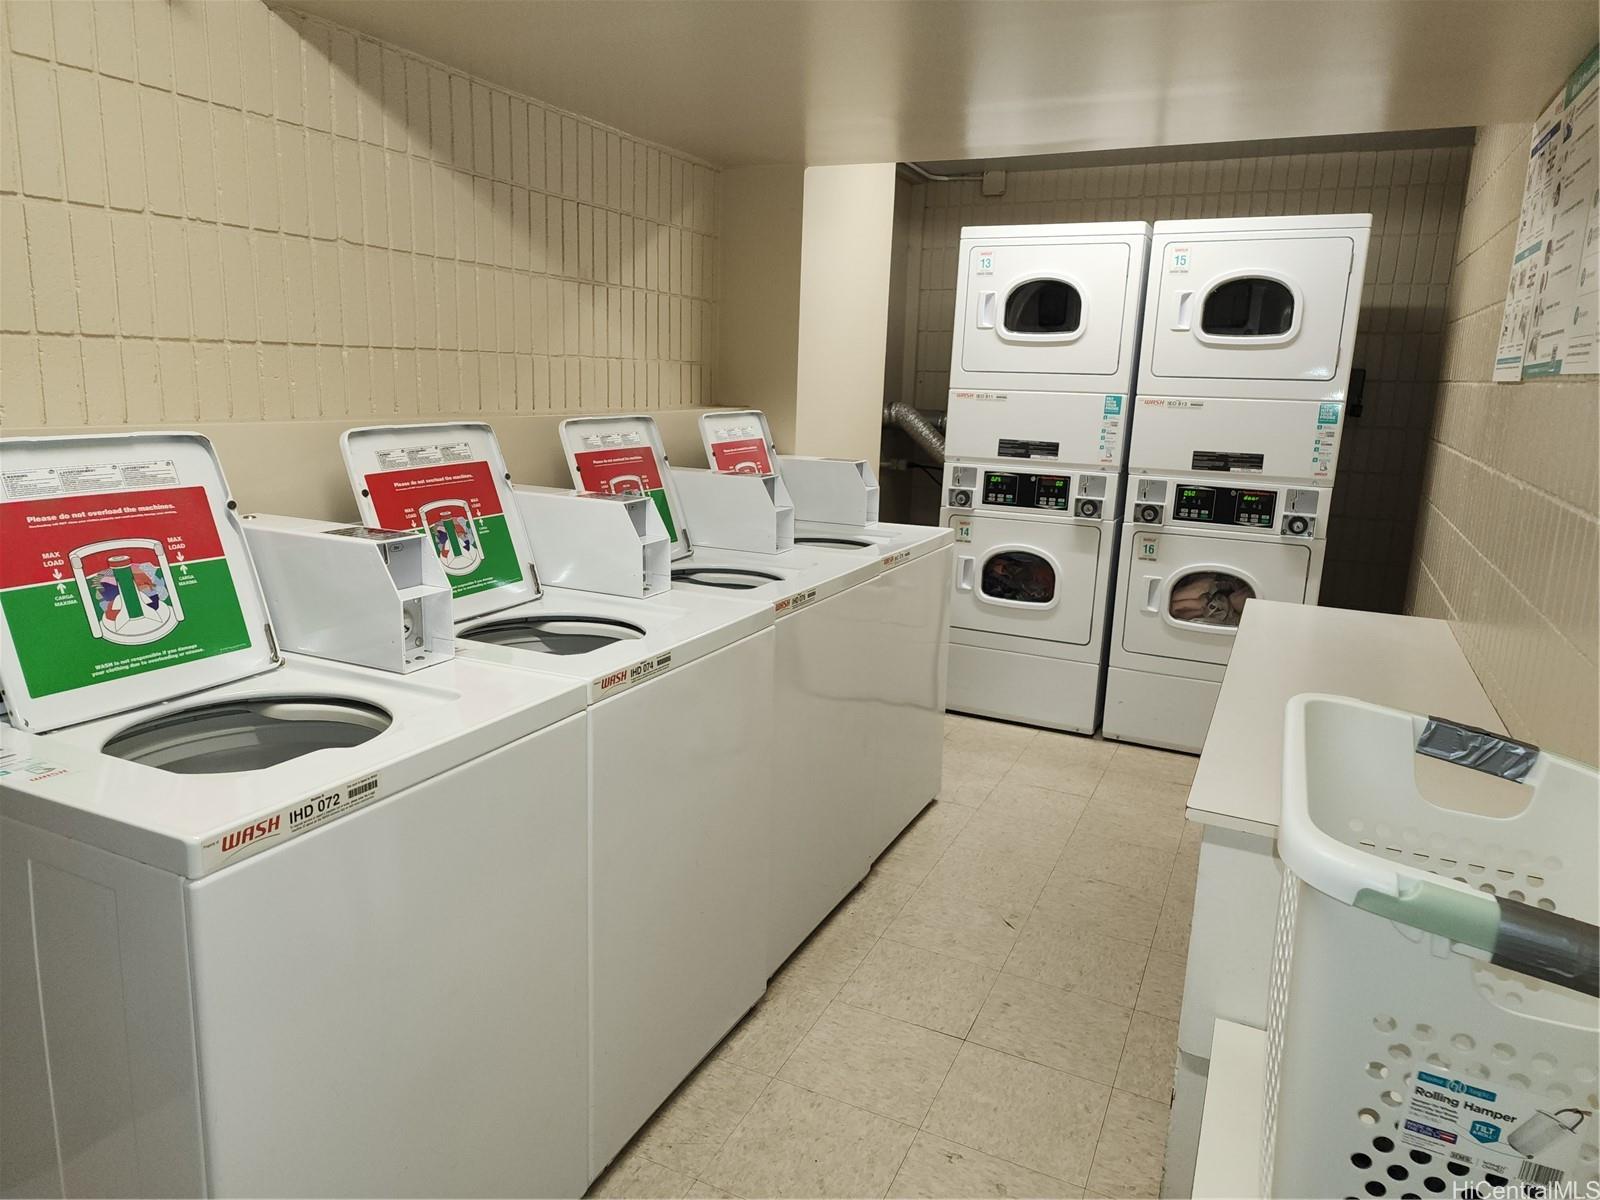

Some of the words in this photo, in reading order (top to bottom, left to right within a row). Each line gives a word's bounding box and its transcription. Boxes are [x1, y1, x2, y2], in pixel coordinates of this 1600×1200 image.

[980, 258, 991, 268] 13
[1174, 255, 1187, 266] 15
[26, 515, 57, 523] Please
[72, 511, 86, 519] not
[88, 508, 123, 516] overload
[137, 503, 176, 512] machines.
[960, 527, 969, 536] 14
[1143, 544, 1155, 554] 16
[42, 551, 61, 559] MAX
[43, 559, 65, 568] LOAD
[94, 662, 113, 670] WASH
[91, 670, 105, 678] your
[601, 670, 627, 689] WASH
[630, 666, 642, 678] IHD
[642, 661, 654, 673] 074
[290, 804, 314, 824] IHD
[318, 793, 341, 812] 072
[221, 814, 281, 852] WASH
[1414, 1086, 1460, 1108] Rolling
[1463, 1101, 1518, 1123] Hamper
[1474, 1123, 1496, 1136] TILT
